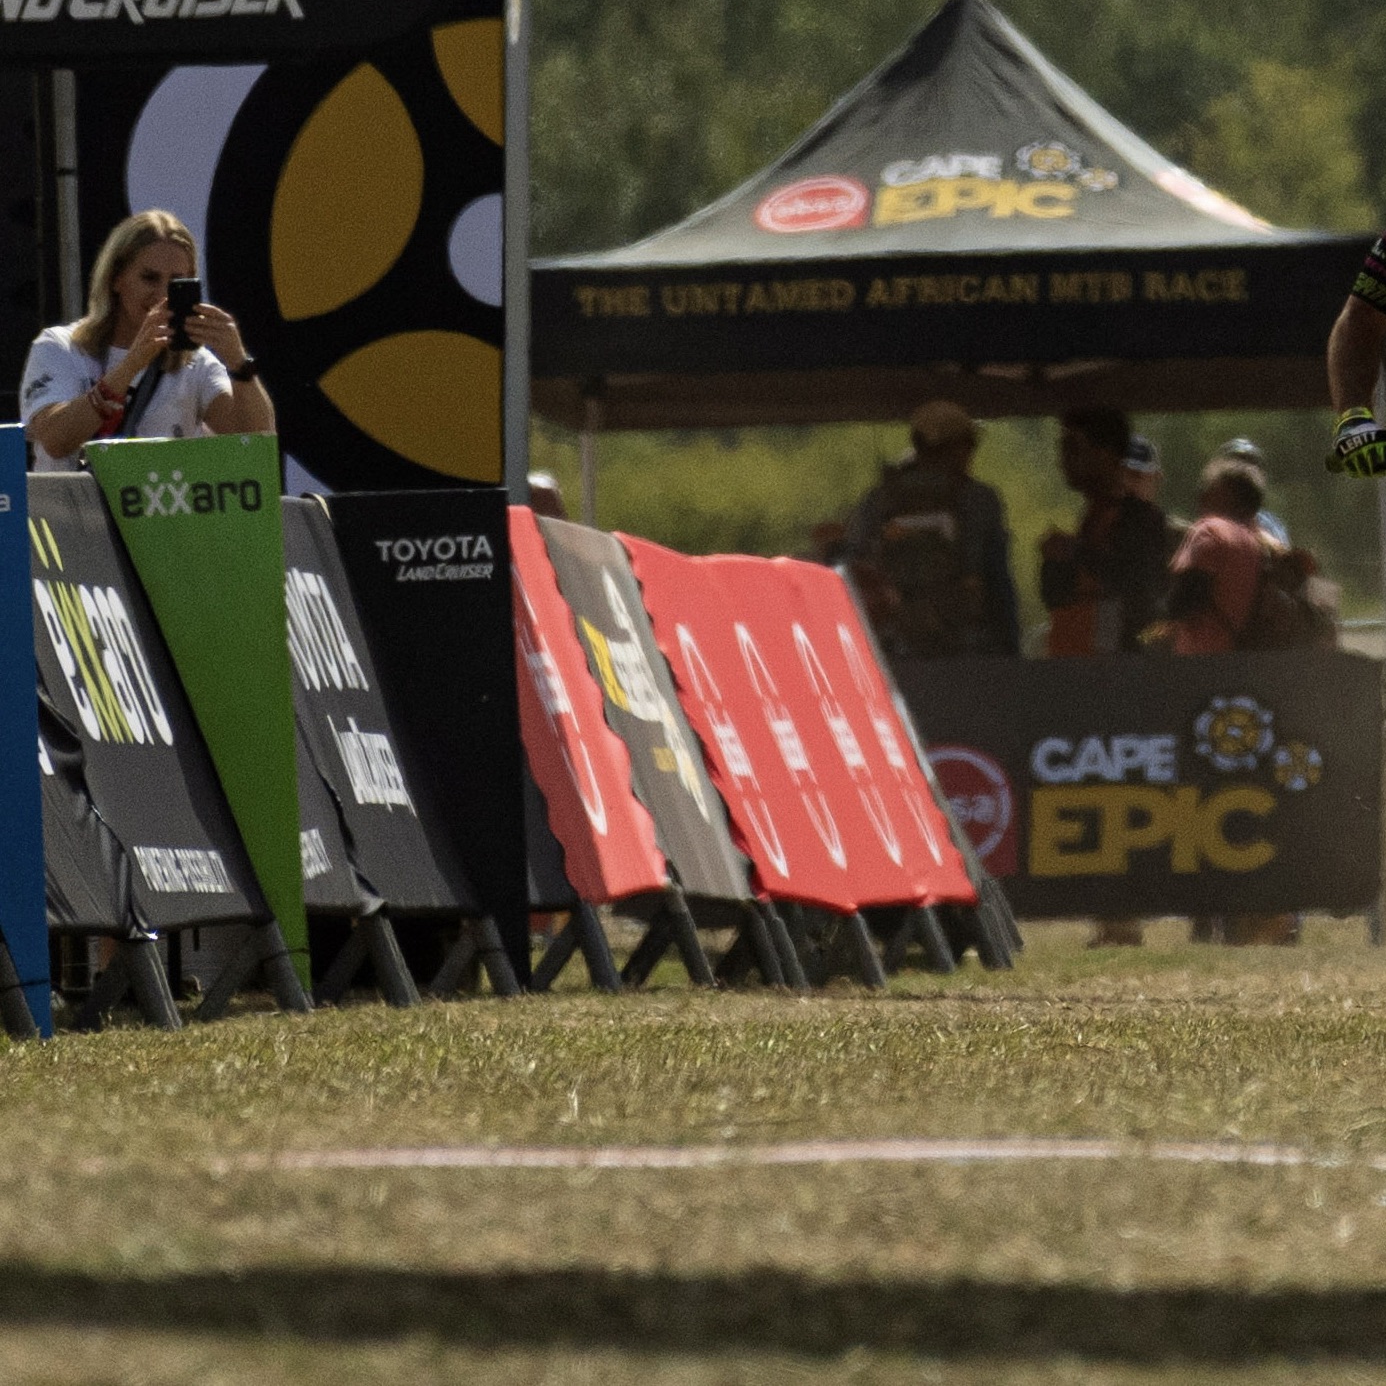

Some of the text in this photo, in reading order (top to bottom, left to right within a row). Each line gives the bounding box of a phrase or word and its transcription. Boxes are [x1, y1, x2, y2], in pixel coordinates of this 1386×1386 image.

[872, 176, 1077, 229] EPIC
[573, 268, 1250, 315] THE UNTAMED AFRICAN MTB RACE
[119, 469, 262, 518] exxaro
[373, 534, 494, 564] TOYOTA
[1031, 736, 1178, 783] CAPE
[1028, 787, 1277, 877] EPIC
